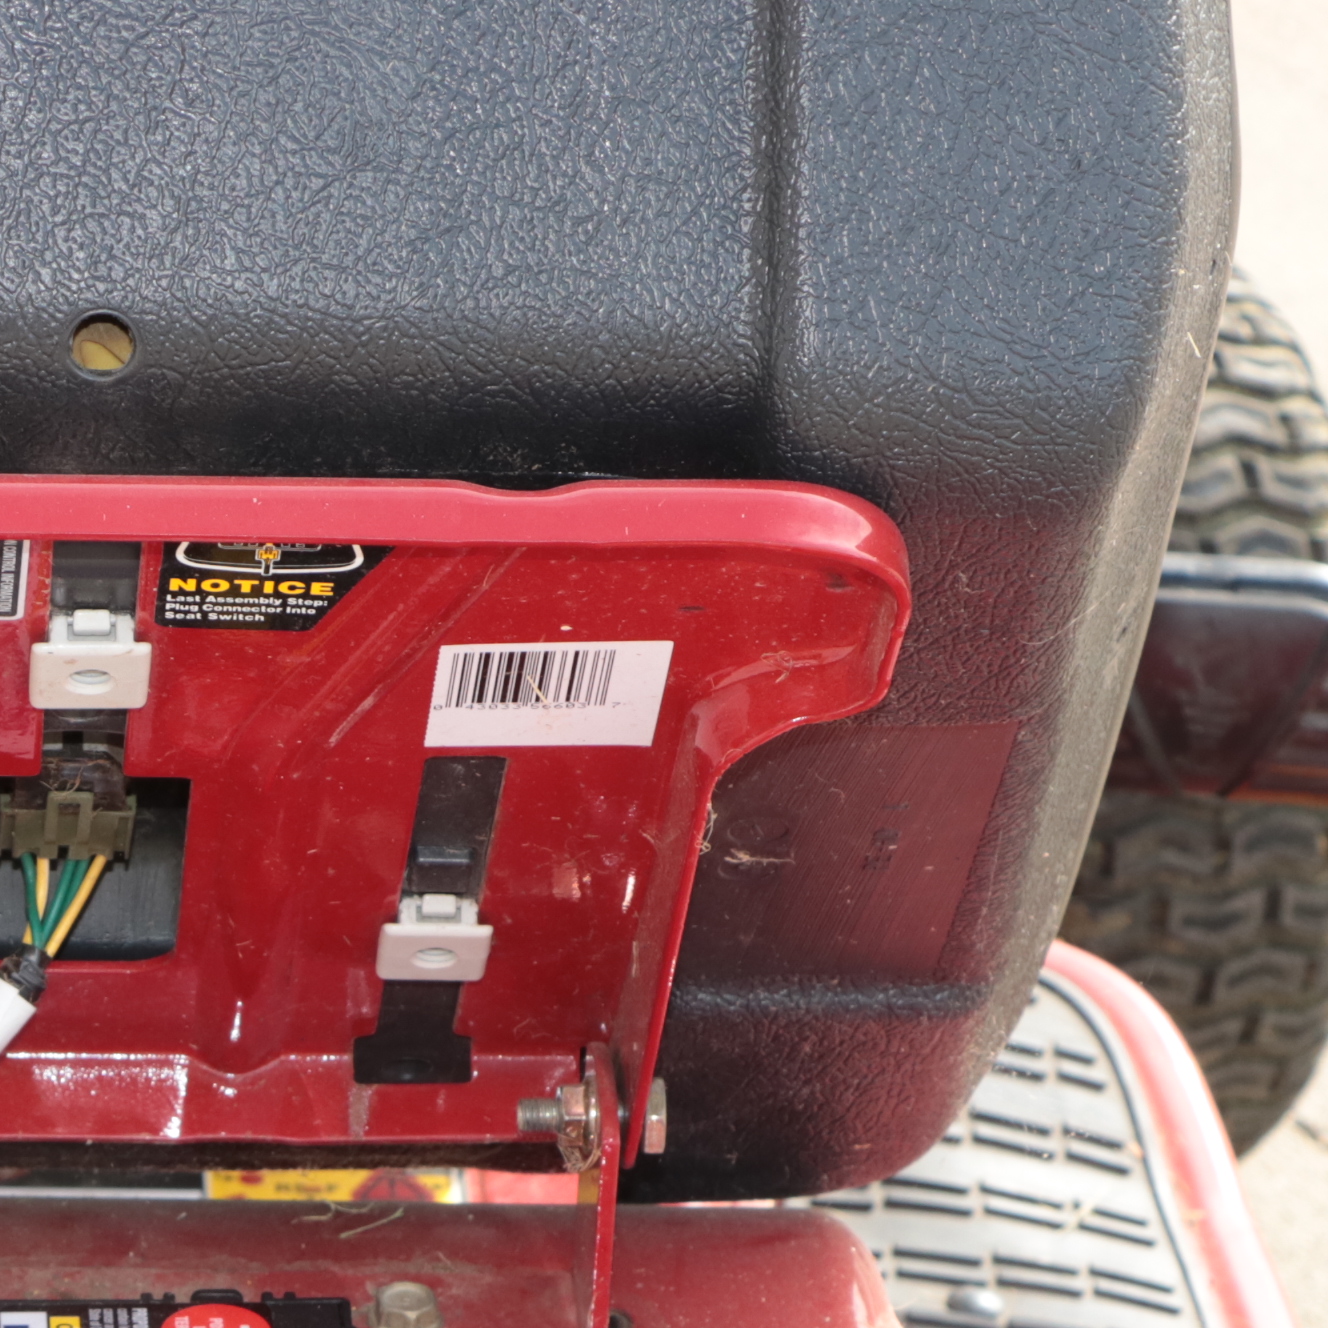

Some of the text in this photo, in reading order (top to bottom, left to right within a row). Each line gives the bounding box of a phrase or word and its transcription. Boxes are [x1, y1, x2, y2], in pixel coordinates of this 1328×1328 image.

[1, 546, 17, 572] CONTROL
[169, 578, 334, 596] NOTICE
[166, 594, 328, 606] Last Assembly Step:
[165, 603, 198, 612] Plug
[203, 604, 283, 613] Connector
[165, 611, 265, 621] Seat Switch
